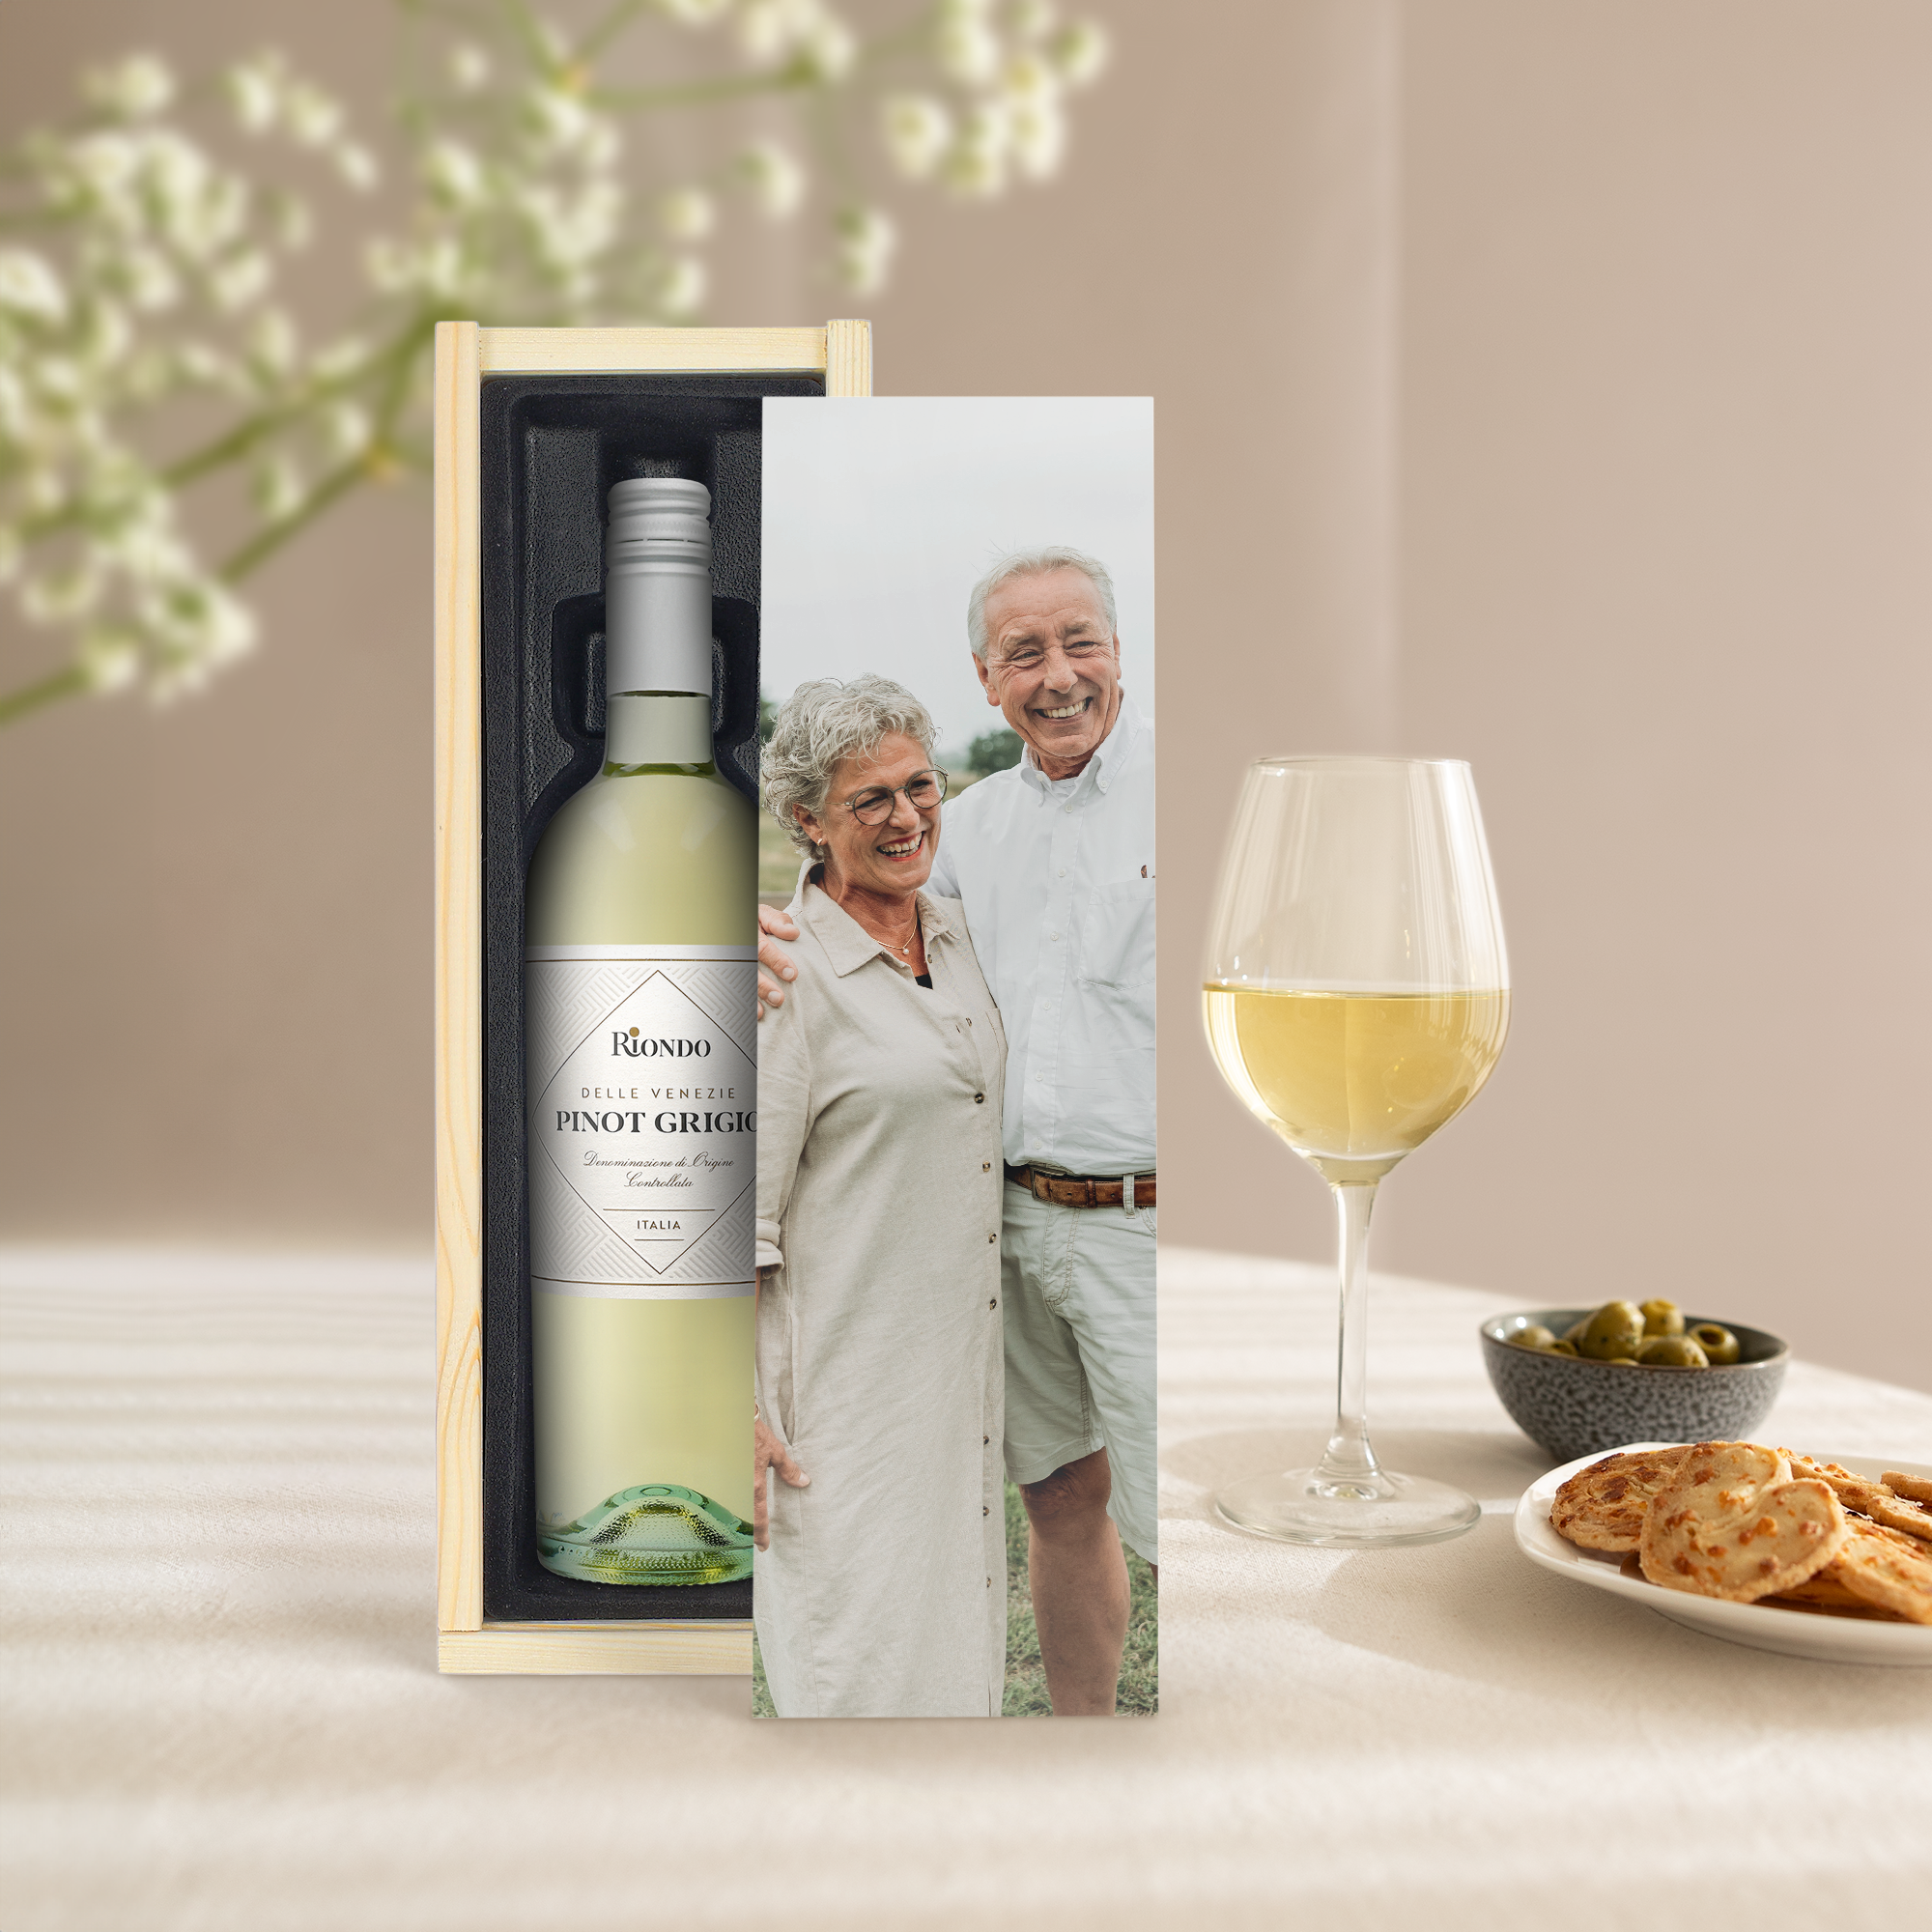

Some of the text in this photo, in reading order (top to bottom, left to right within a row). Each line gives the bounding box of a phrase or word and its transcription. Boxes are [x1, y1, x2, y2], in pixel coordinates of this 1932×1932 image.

[582, 1088, 736, 1099] DELLE VENEZIE
[556, 1111, 646, 1132] PINOT
[583, 1151, 734, 1172] Denominazione di Origine
[623, 1172, 694, 1188] Controllata
[637, 1220, 681, 1230] ITALIA
